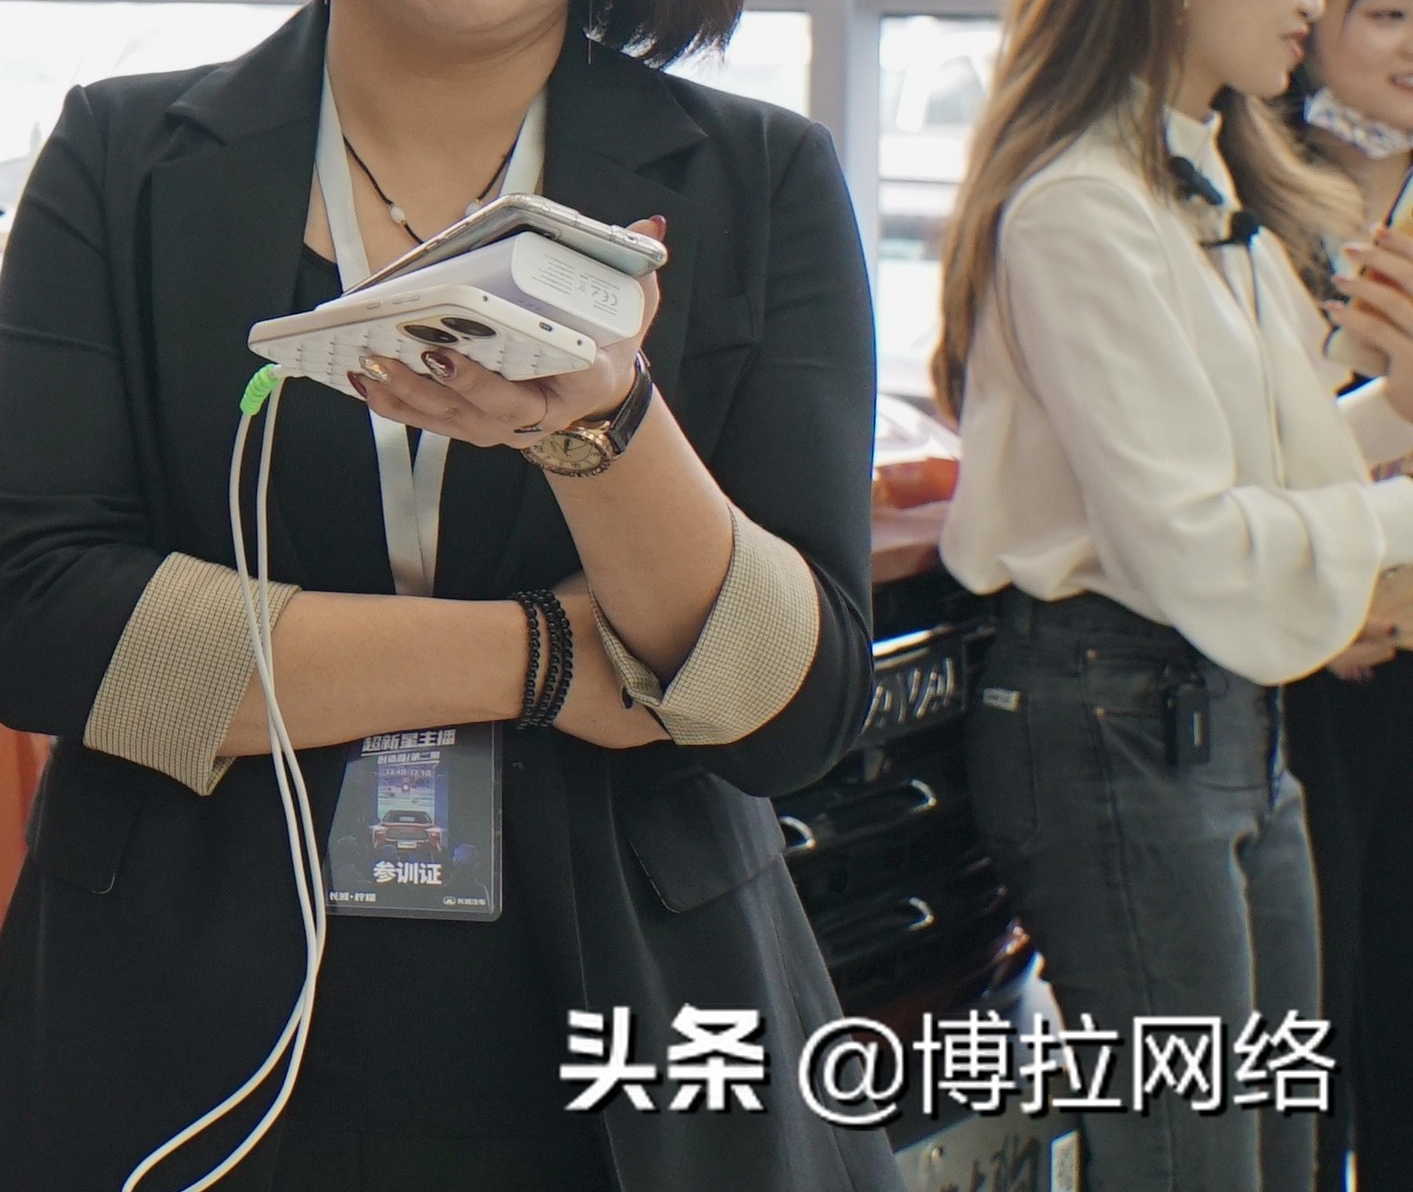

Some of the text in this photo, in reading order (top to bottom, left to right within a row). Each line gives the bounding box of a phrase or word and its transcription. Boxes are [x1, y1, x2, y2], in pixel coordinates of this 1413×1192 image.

[860, 656, 956, 736] AVAL
[361, 728, 457, 753] 超新星主播
[373, 860, 443, 886] 参训证
